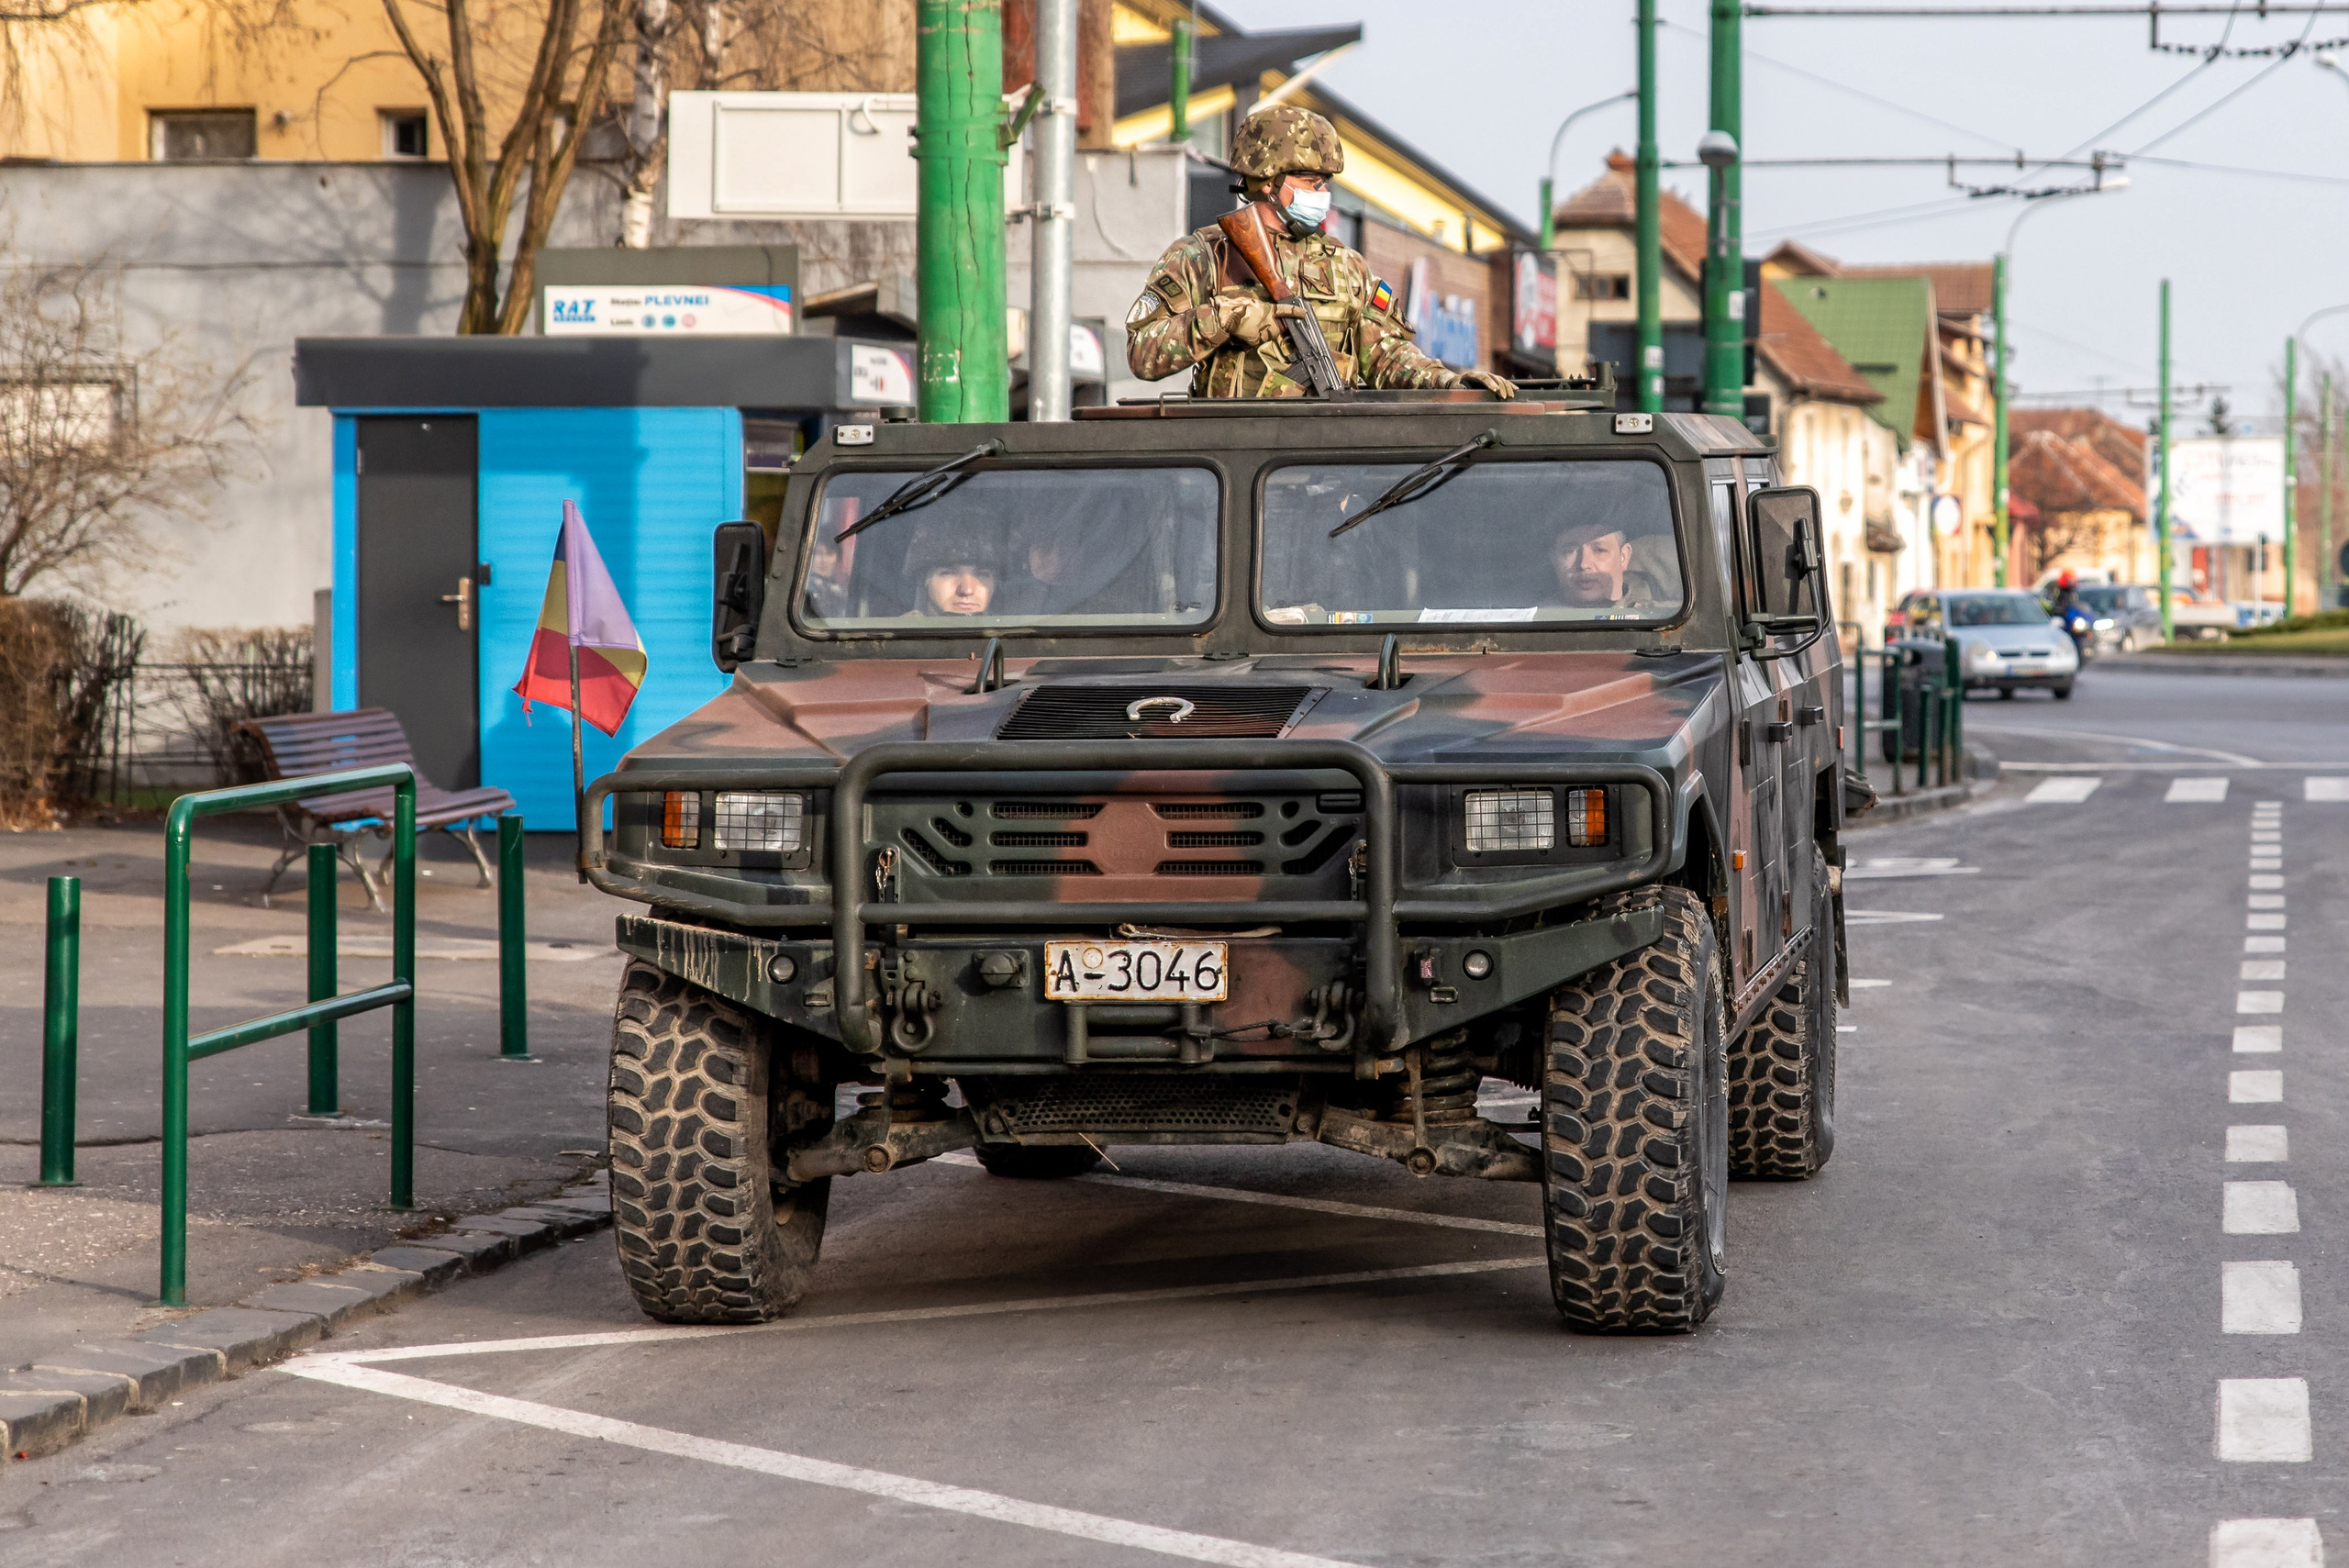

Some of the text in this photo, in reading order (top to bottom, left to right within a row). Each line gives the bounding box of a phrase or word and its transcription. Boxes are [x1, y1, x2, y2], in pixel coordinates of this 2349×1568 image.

[553, 300, 596, 315] RAT
[644, 295, 709, 306] PLEVNEI
[1054, 948, 1221, 993] A-3046
